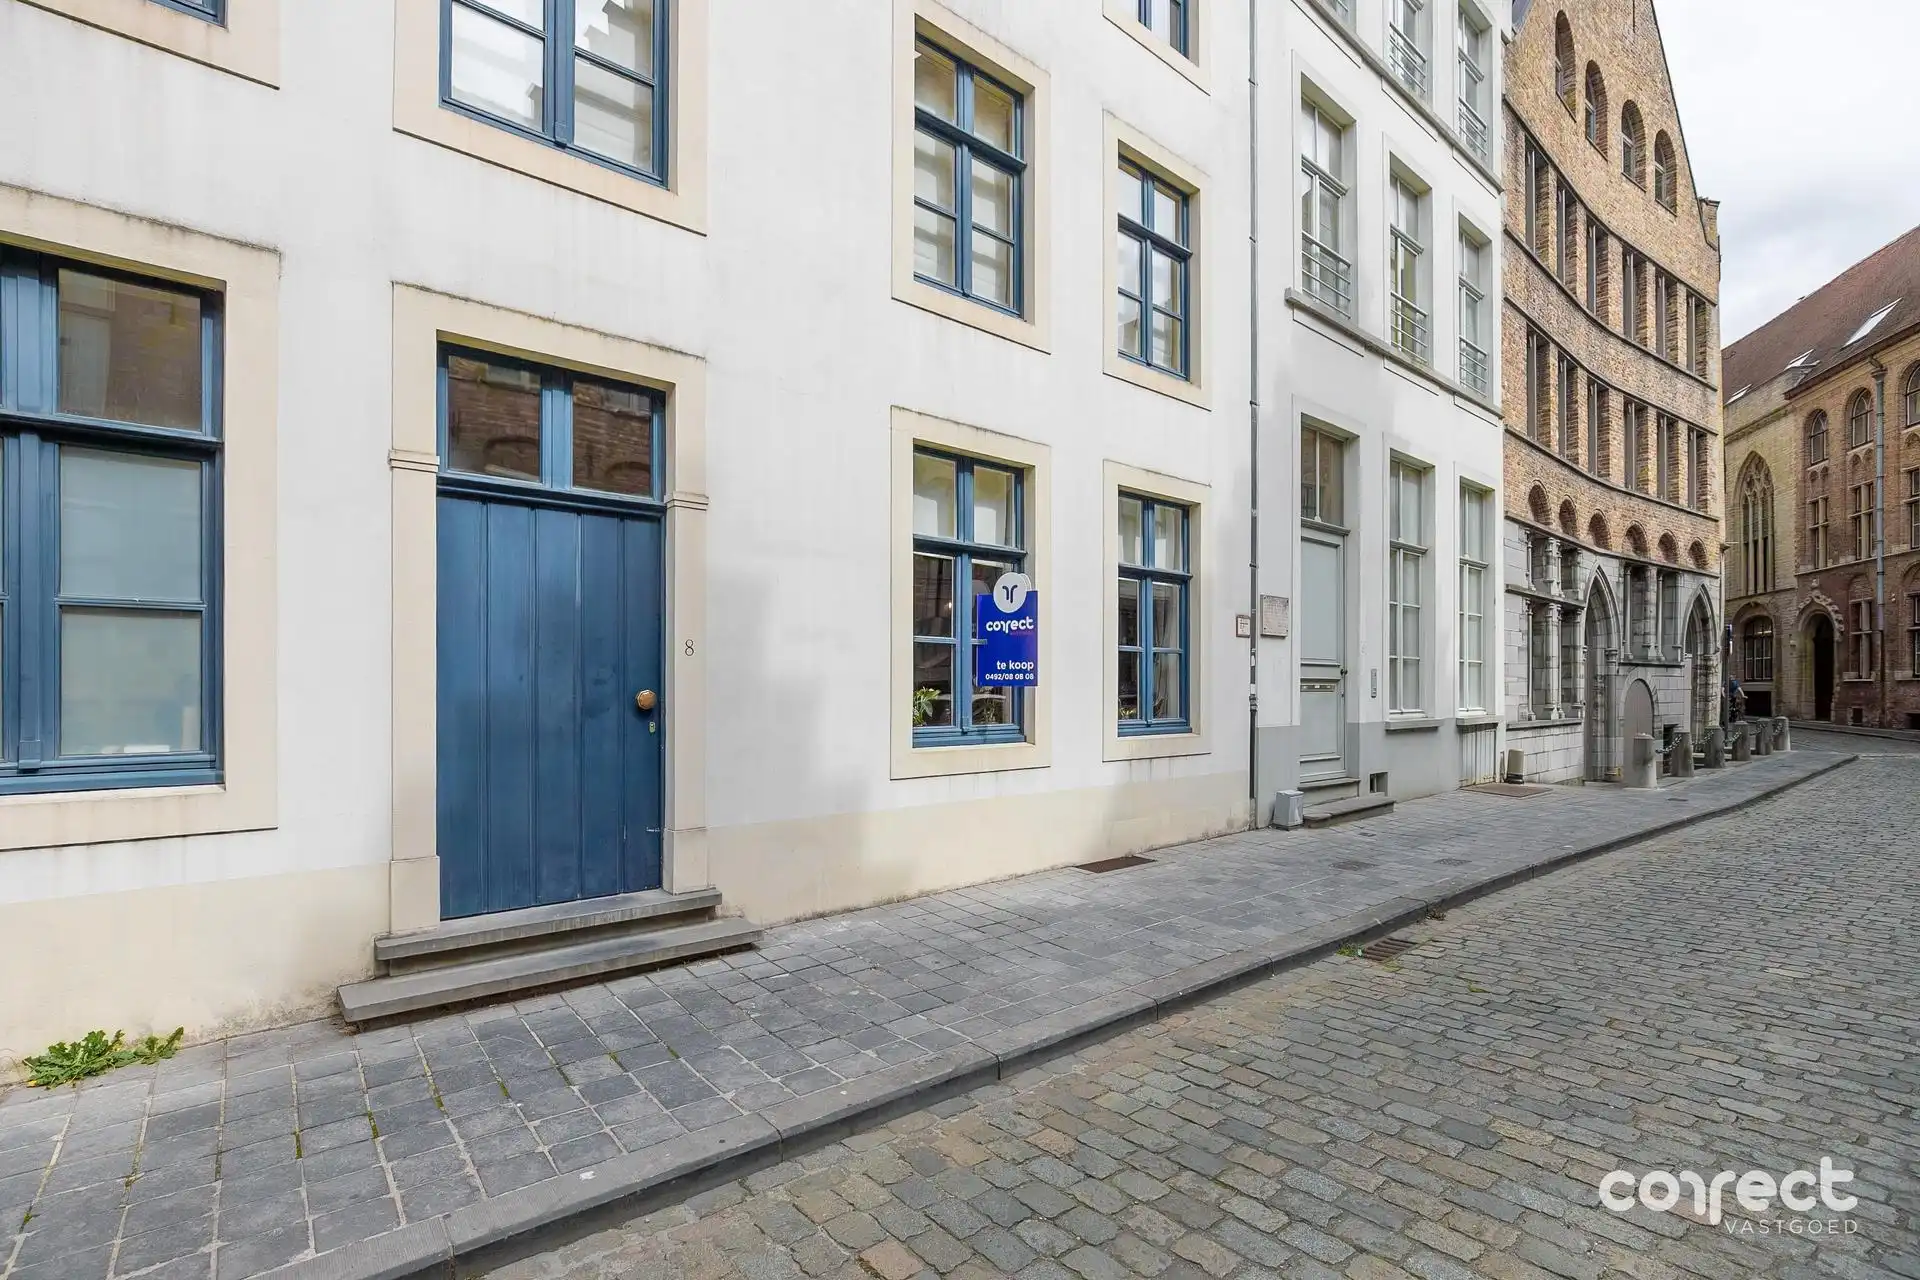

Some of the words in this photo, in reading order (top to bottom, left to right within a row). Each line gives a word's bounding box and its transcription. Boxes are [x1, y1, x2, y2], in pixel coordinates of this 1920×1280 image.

[685, 639, 694, 656] 8
[997, 660, 1007, 670] te
[1009, 660, 1034, 671] koop
